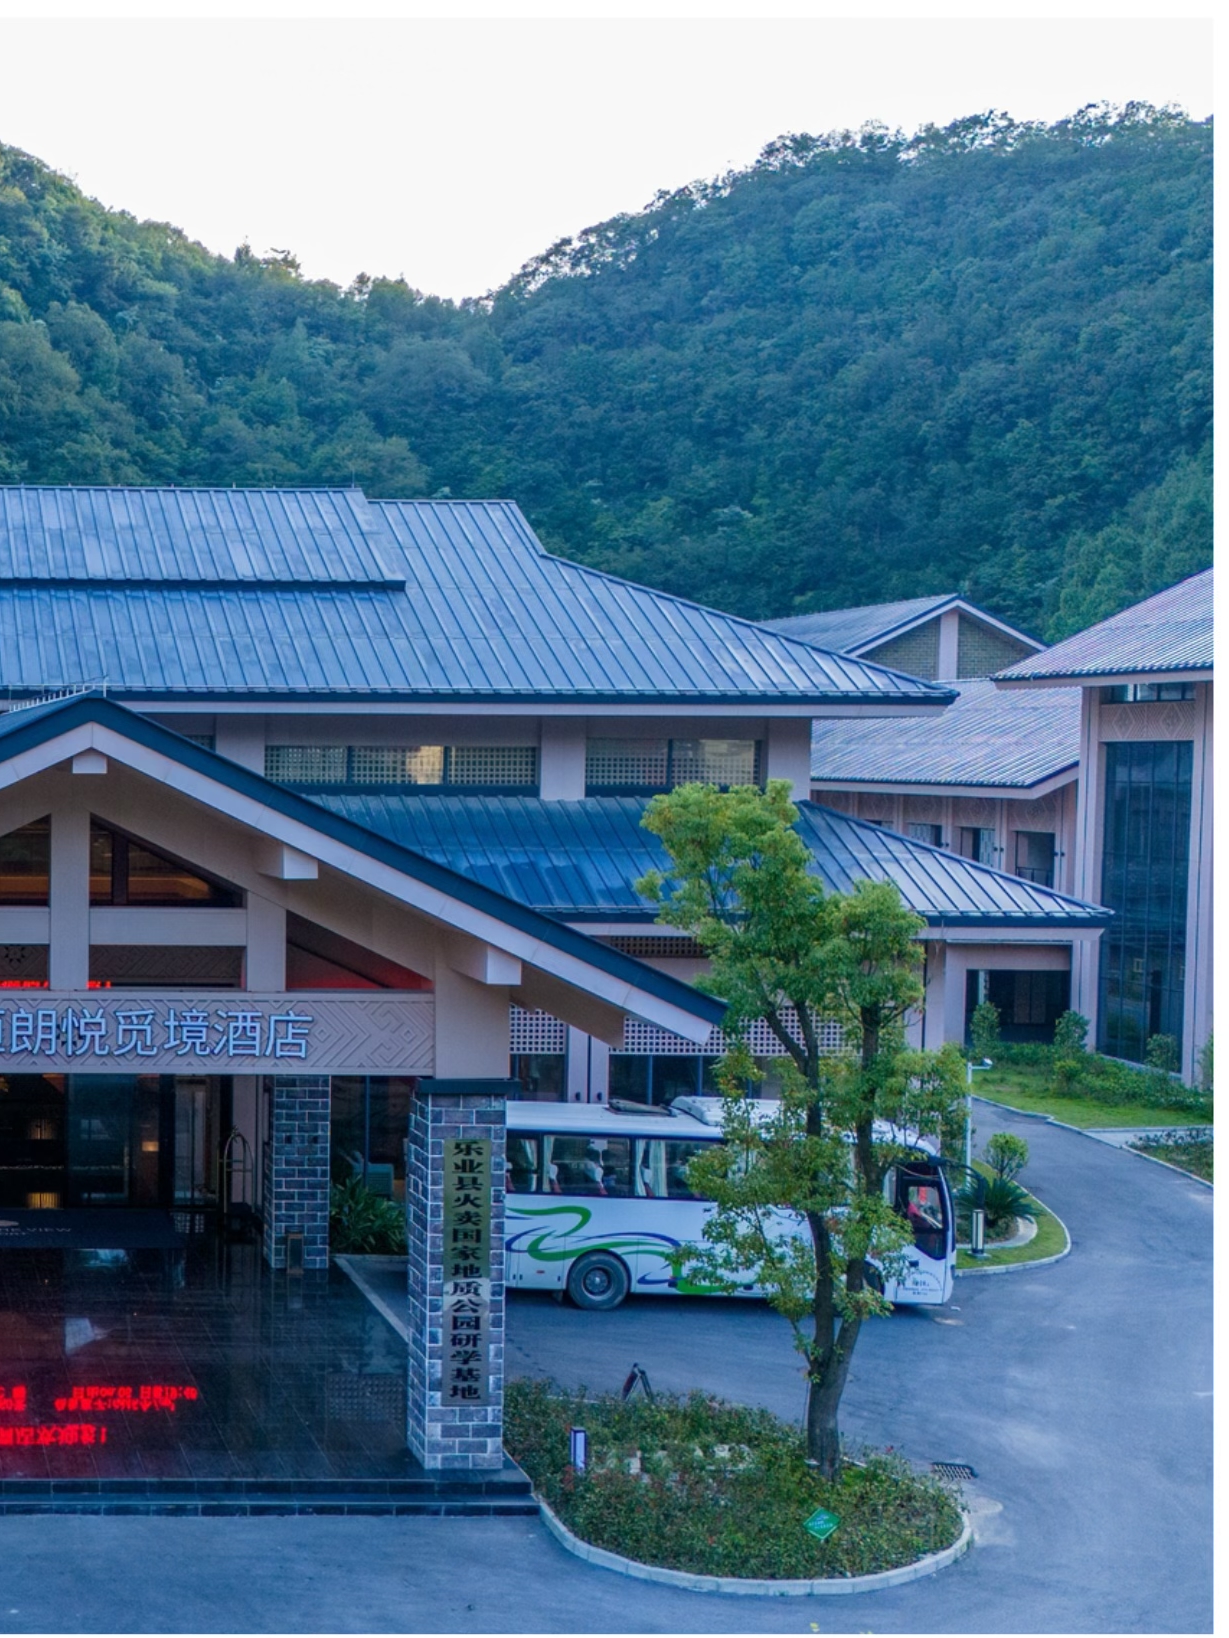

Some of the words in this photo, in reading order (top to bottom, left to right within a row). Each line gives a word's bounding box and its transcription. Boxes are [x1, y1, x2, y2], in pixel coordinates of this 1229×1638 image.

[450, 1140, 484, 1400] 乐业县火卖国家地质公园研学基地
